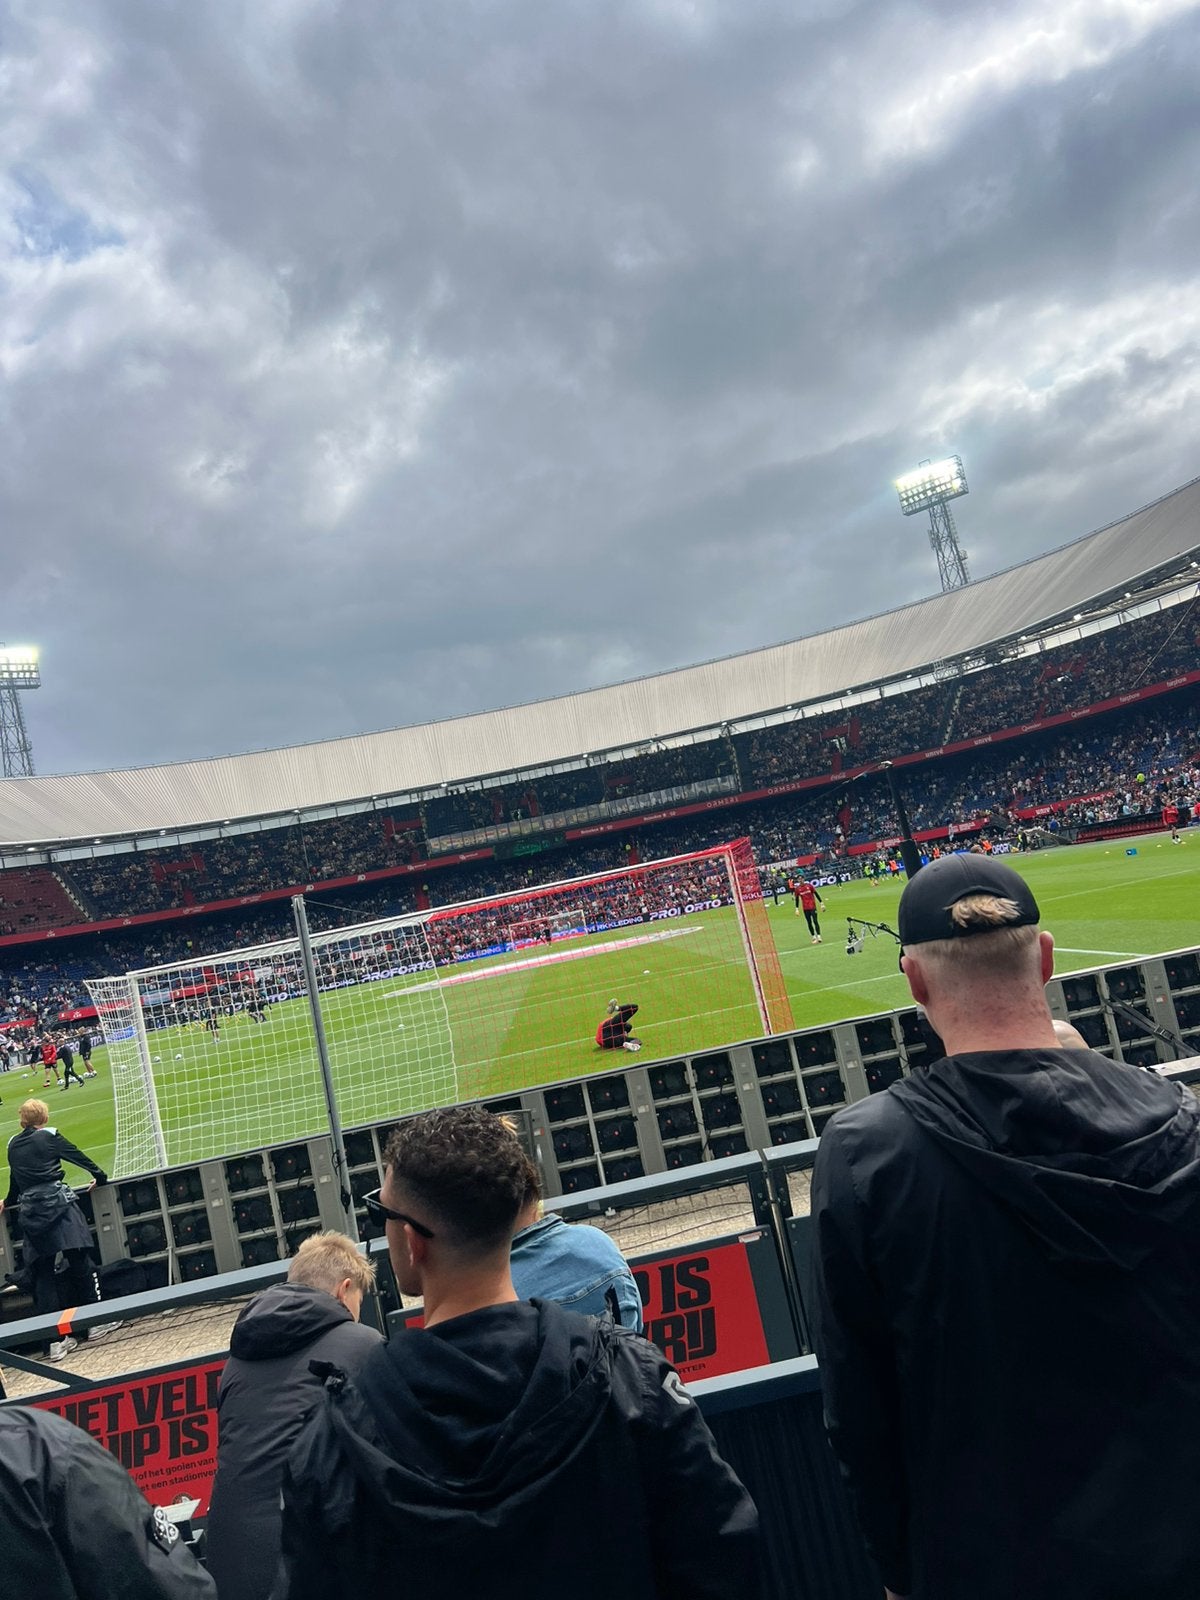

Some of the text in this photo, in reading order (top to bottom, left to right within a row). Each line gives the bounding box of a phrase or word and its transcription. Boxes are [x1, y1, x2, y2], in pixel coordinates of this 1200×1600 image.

[650, 898, 721, 921] PROORTO
[658, 1256, 711, 1314] IS
[643, 1306, 717, 1364] RIJ
[168, 1414, 209, 1460] IS
[197, 1457, 214, 1467] van
